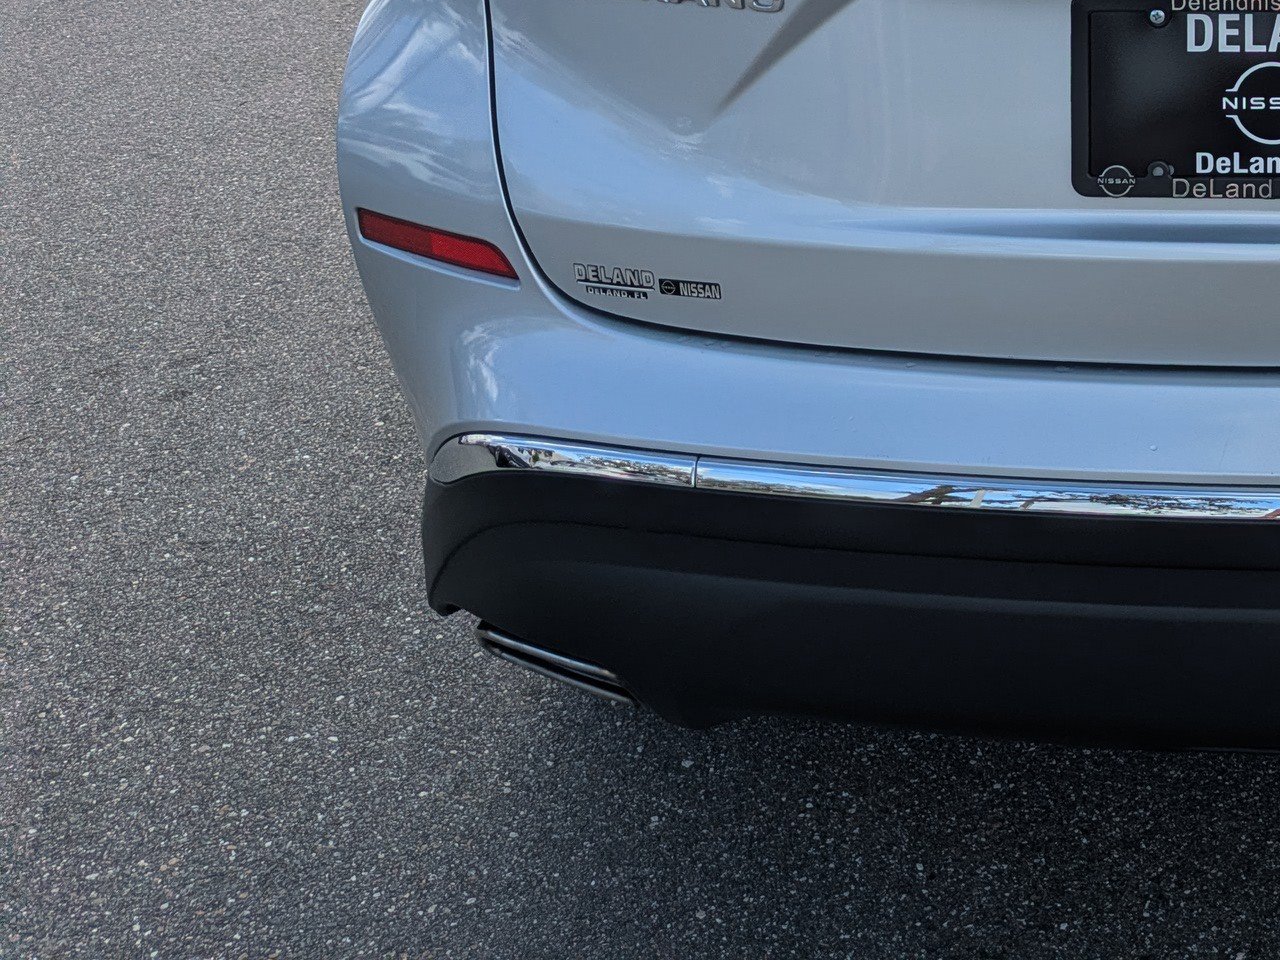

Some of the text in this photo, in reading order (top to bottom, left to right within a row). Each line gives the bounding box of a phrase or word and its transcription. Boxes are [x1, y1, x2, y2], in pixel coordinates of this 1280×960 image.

[1172, 178, 1272, 198] DeLand
[573, 263, 655, 287] DELAND
[679, 282, 721, 299] NISSAN
